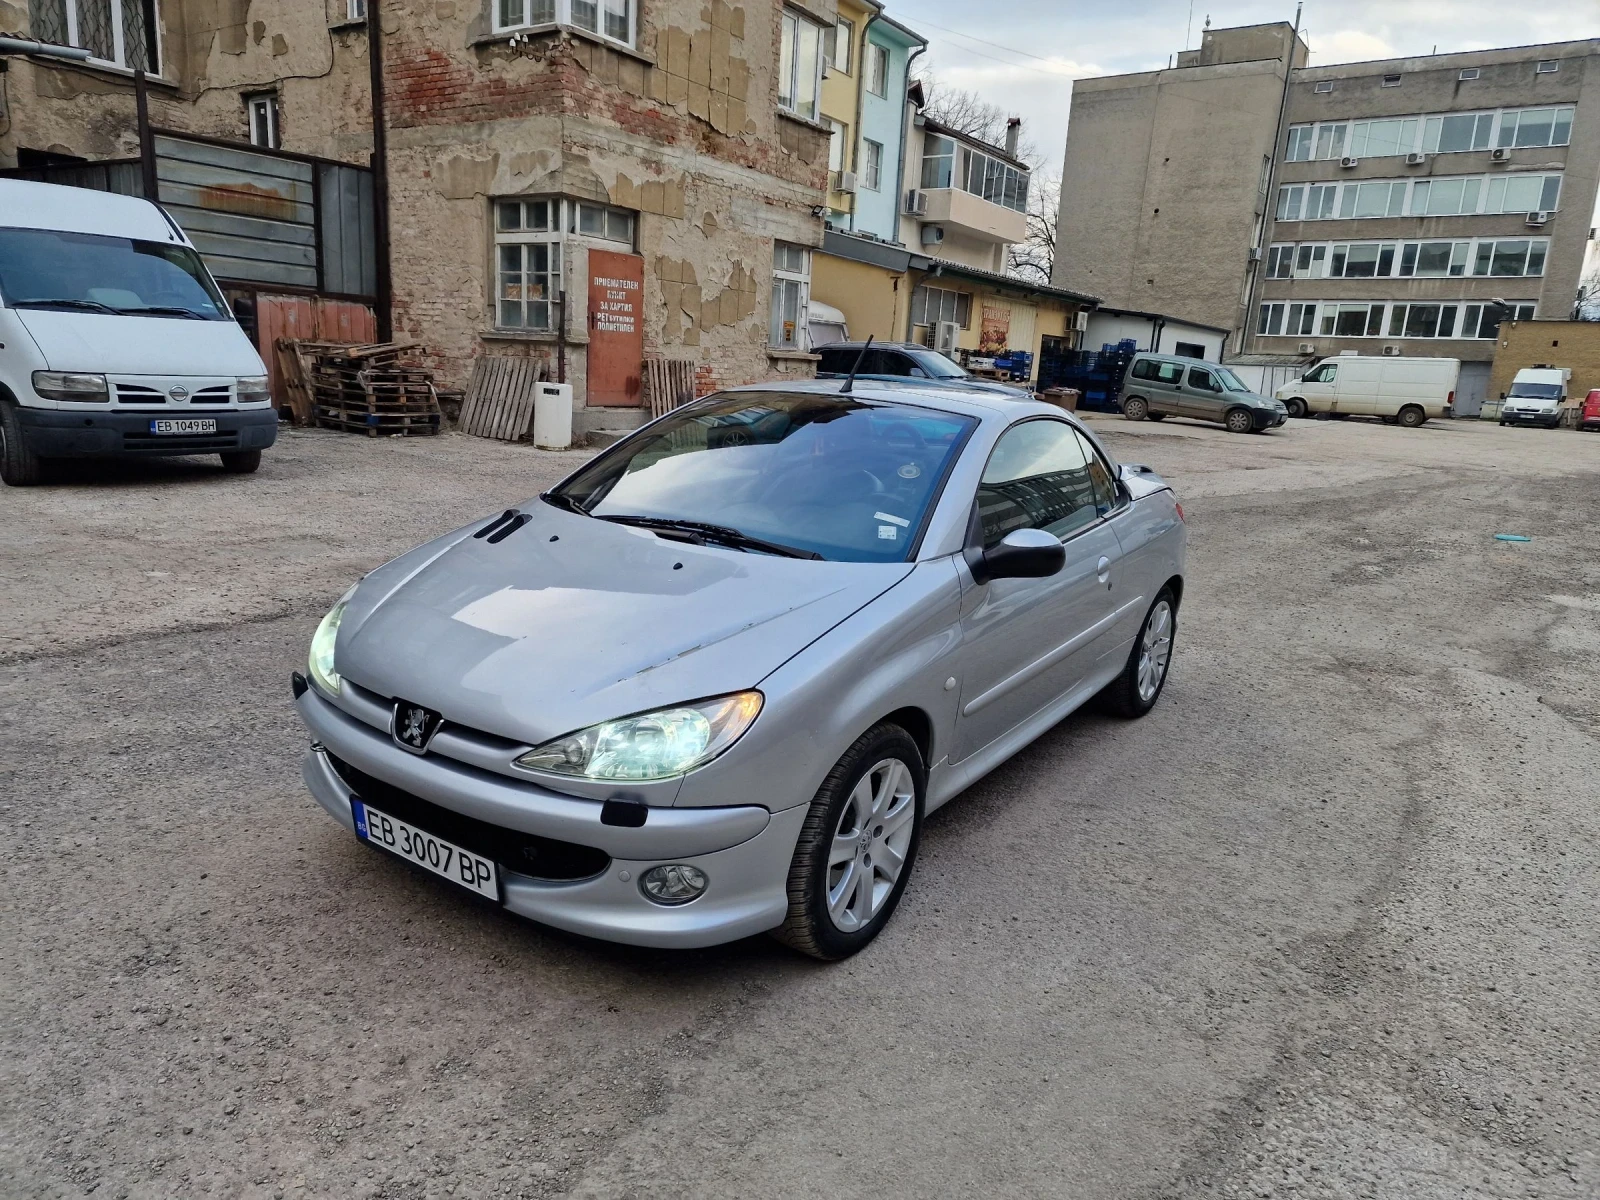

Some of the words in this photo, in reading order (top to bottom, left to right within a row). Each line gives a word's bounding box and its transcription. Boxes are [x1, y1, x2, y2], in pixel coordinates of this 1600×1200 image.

[594, 277, 639, 290] ПРИЕМАТЕЛЕН
[600, 301, 608, 310] ЗА
[609, 303, 632, 312] ХАРТИЯ
[597, 321, 634, 332] ПОЛИЕТИЛЕН
[157, 421, 172, 432] EB
[175, 421, 199, 432] 1049
[366, 809, 396, 847] EB
[400, 825, 453, 873] 3007
[458, 851, 491, 889] BP
